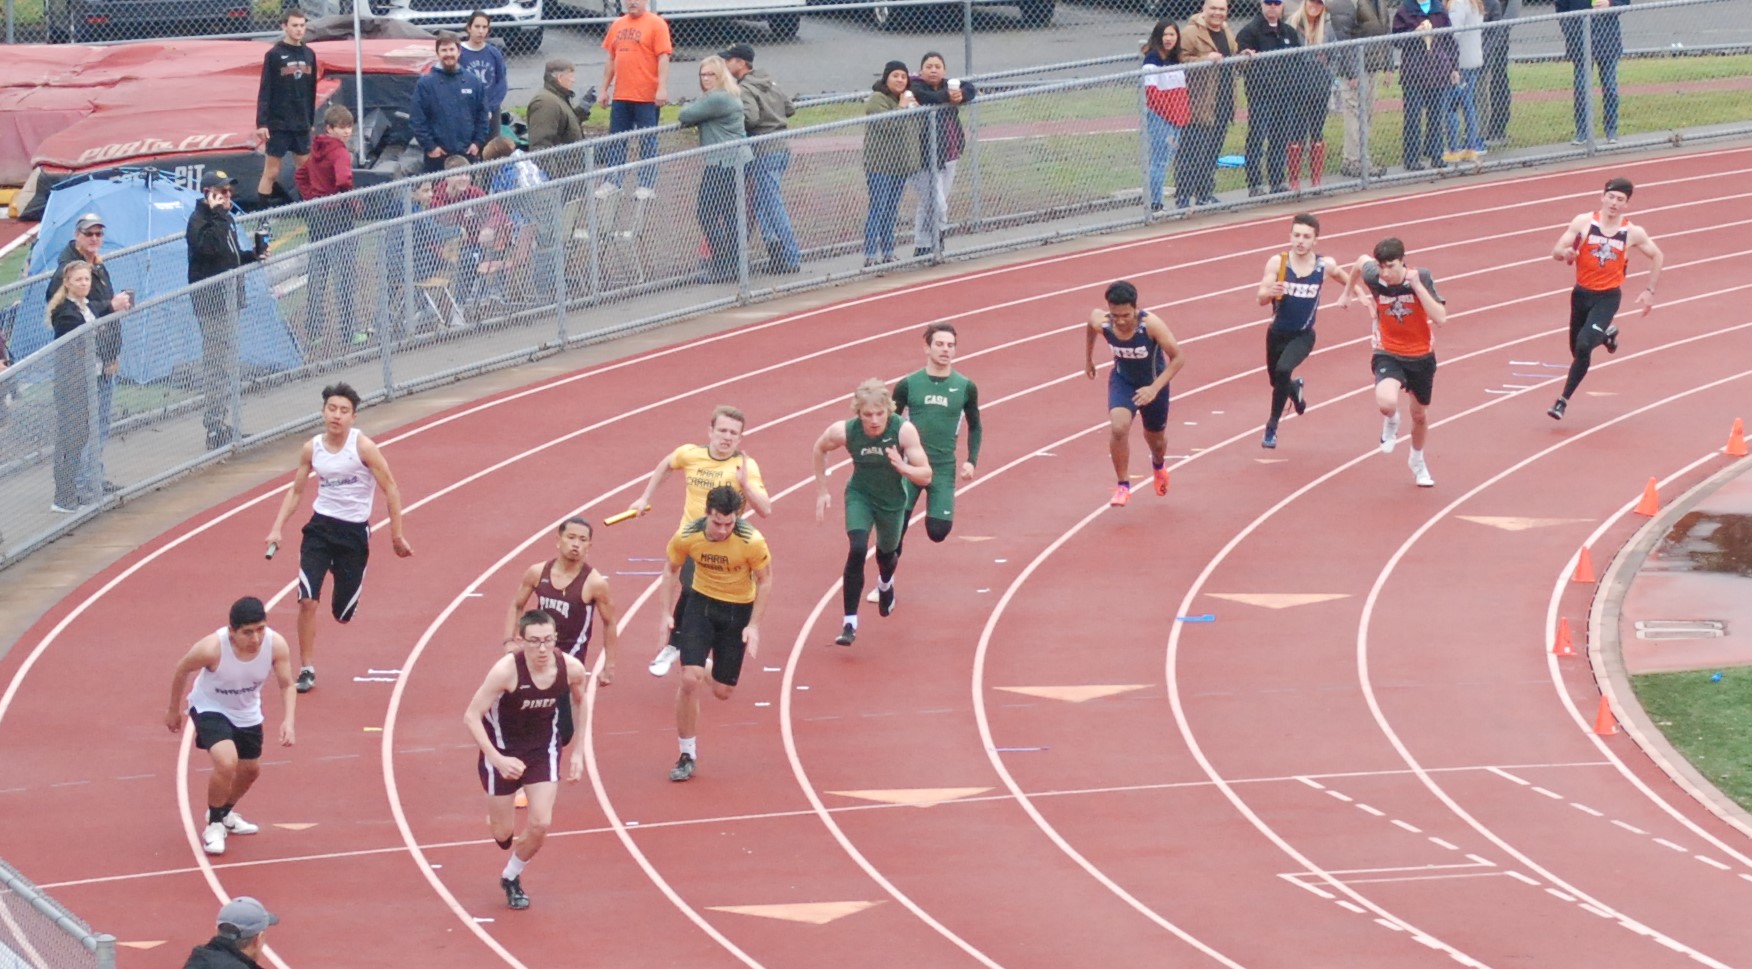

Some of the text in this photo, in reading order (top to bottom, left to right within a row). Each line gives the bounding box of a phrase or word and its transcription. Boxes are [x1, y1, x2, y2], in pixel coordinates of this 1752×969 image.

[924, 395, 948, 407] CASA
[861, 447, 883, 456] CASA
[696, 468, 724, 478] MARIA
[701, 553, 730, 565] MARIA
[540, 596, 569, 619] PINER
